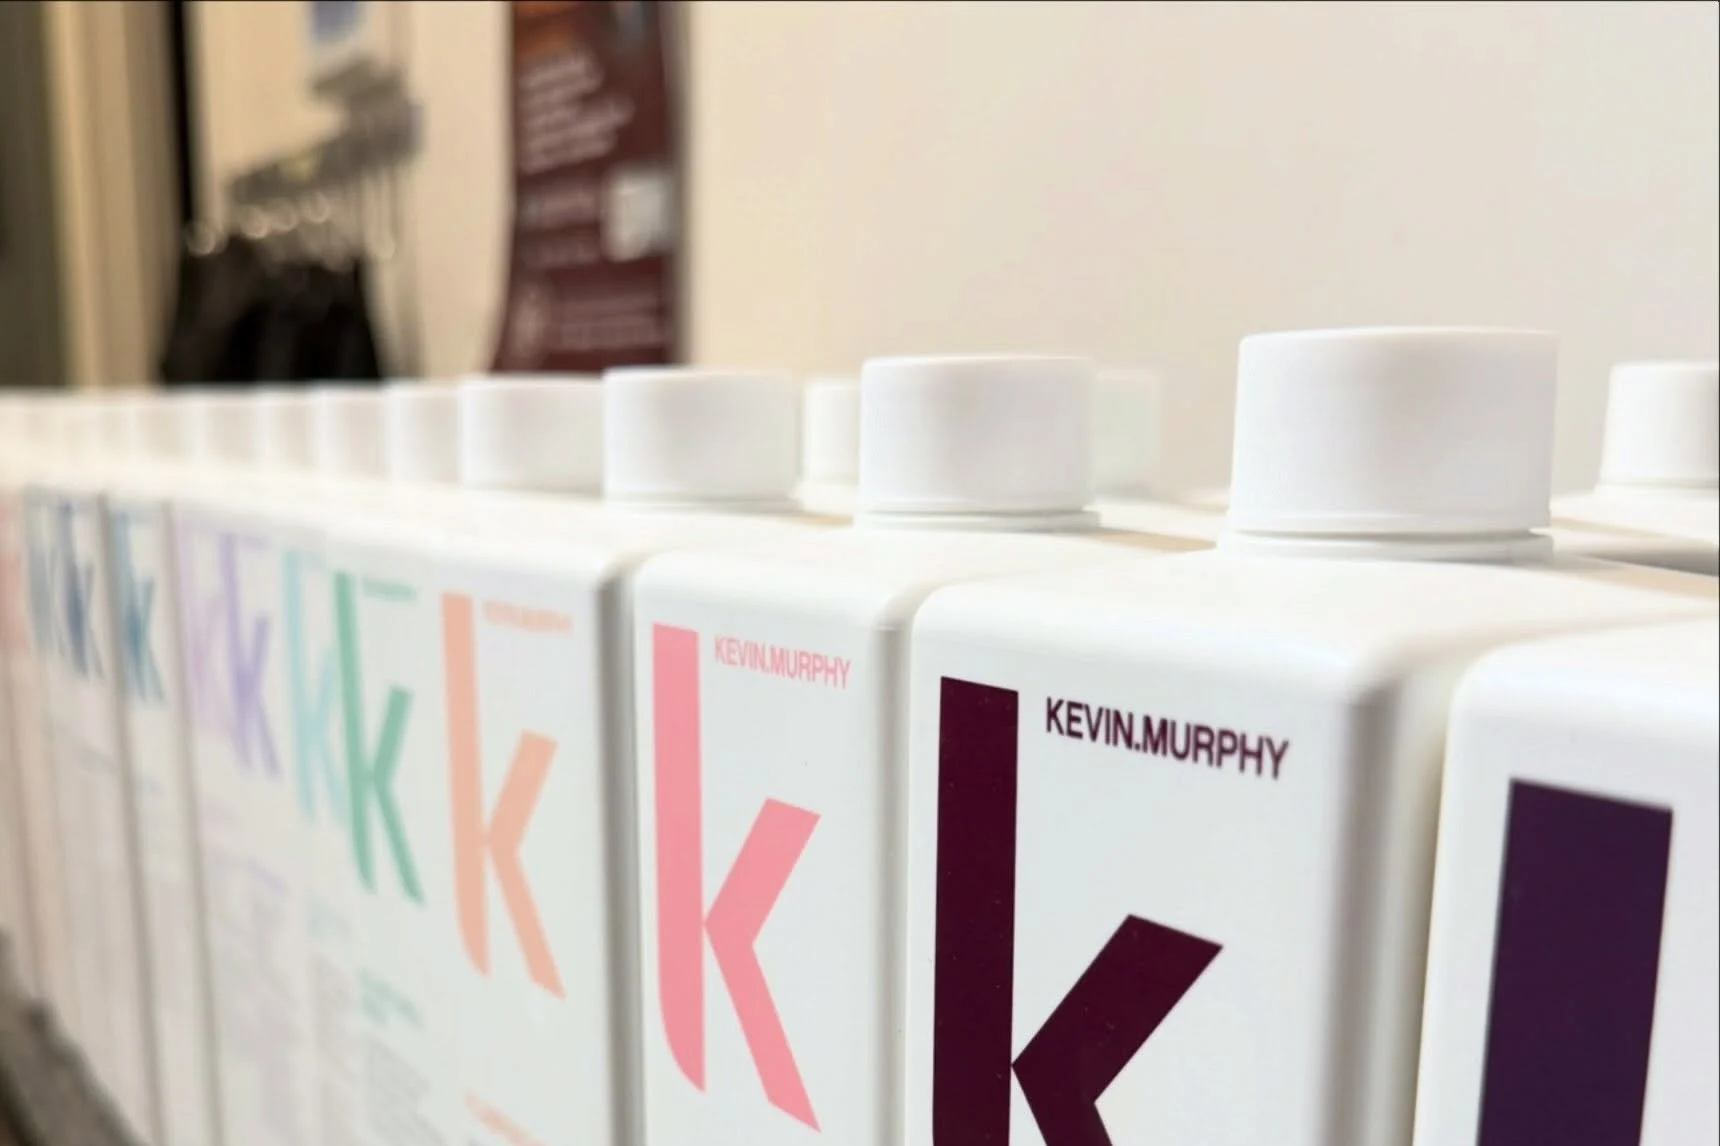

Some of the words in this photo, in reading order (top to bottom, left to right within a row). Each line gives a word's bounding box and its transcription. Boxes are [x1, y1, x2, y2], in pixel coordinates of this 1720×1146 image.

[713, 634, 851, 690] KEVIN.MURPHY
[1045, 696, 1290, 779] KEVIN.MURPHY
[441, 592, 564, 1000] k
[653, 622, 820, 1133] k
